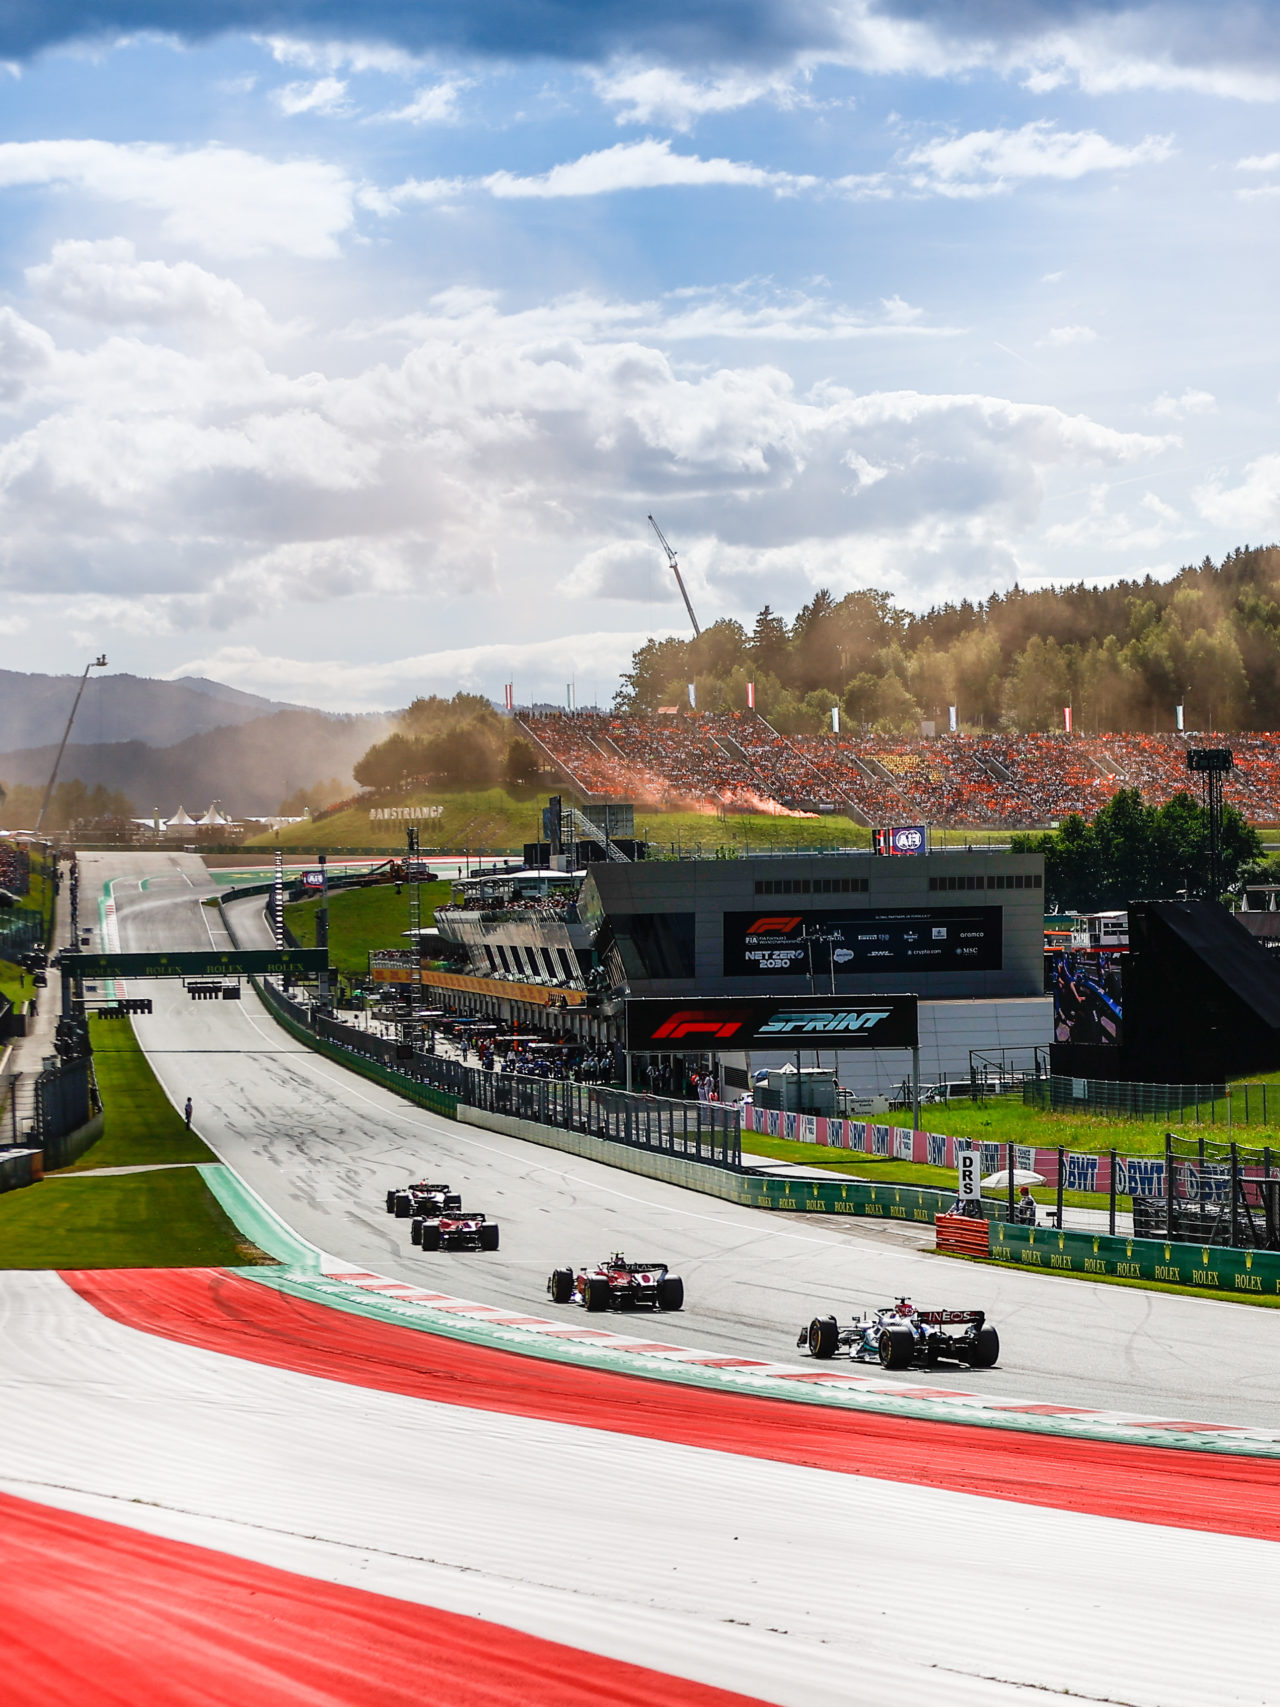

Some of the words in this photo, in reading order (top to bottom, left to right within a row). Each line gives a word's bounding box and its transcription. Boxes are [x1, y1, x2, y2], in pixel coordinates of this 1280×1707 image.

[369, 806, 444, 820] #AUSTRIANGP
[746, 917, 803, 934] F1
[746, 951, 771, 960] NET
[772, 950, 804, 960] ZERO
[146, 966, 182, 974] ROLEX
[206, 964, 244, 974] ROLEX
[268, 963, 304, 972] ROLEX
[760, 960, 790, 968] 2030
[651, 1011, 750, 1039] F1
[759, 1012, 890, 1032] SPRINT
[933, 1134, 946, 1167] BWT
[962, 1156, 974, 1194] DRS
[1068, 1154, 1098, 1192] BWT
[1130, 1160, 1164, 1196] BWT
[779, 1198, 796, 1209] ROLEX
[806, 1200, 826, 1211] ROLEX
[834, 1202, 854, 1213] ROLEX
[865, 1204, 883, 1216] ROLEX
[890, 1206, 906, 1218] ROLEX
[1022, 1250, 1042, 1264] ROLEX
[1050, 1254, 1072, 1269] ROLEX
[1084, 1258, 1106, 1274] ROLEX
[1117, 1262, 1141, 1278] ROLEX
[1155, 1266, 1180, 1282] ROLEX
[1192, 1270, 1219, 1286] ROLEX
[1235, 1274, 1262, 1291] ROLEX
[928, 1312, 971, 1321] INEOS
